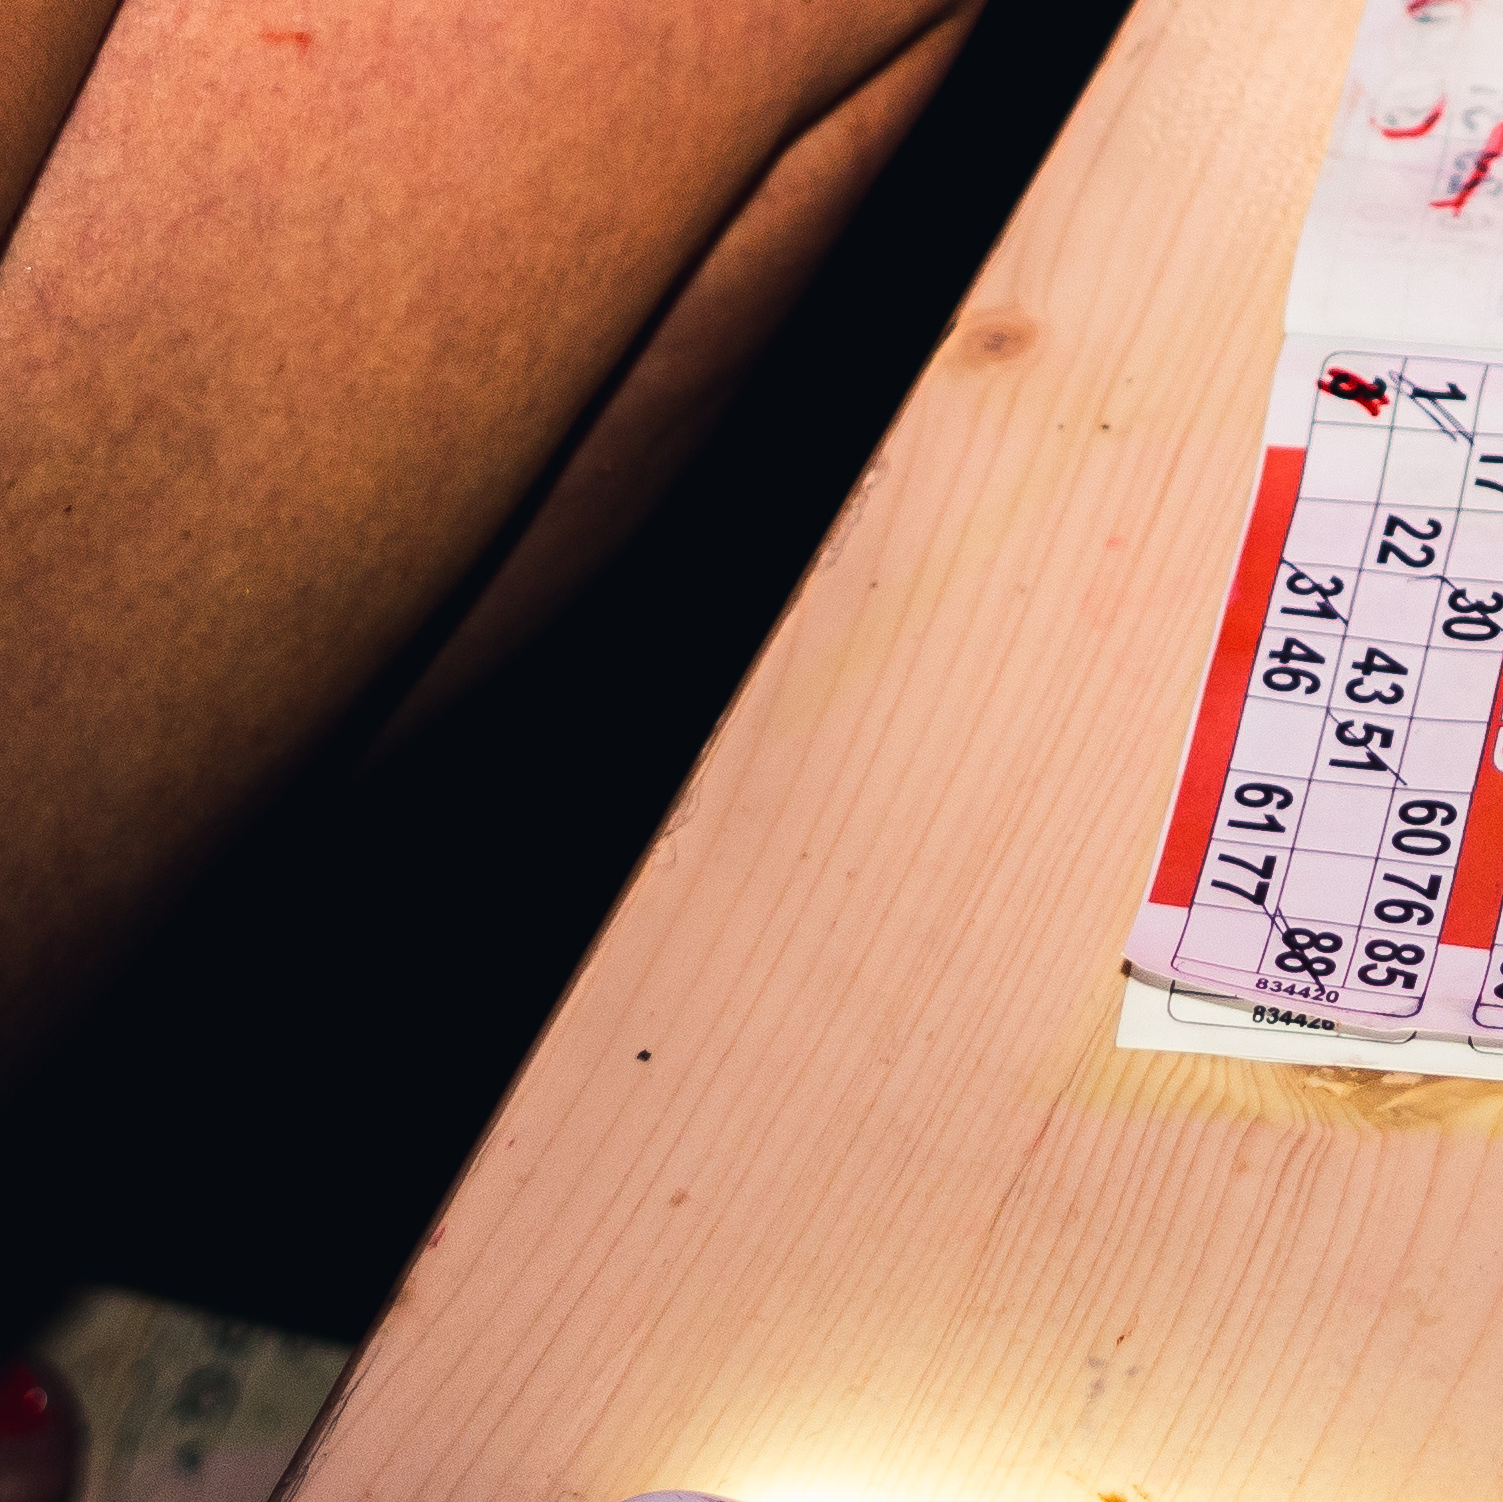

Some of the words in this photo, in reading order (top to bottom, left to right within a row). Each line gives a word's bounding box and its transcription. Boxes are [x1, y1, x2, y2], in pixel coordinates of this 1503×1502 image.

[1376, 514, 1442, 569] 22
[1261, 636, 1328, 696] 46
[1344, 647, 1409, 707] 43
[1329, 719, 1394, 774] 51
[1228, 783, 1294, 836] 61
[1391, 799, 1458, 857] 60
[1211, 853, 1278, 906] 77
[1374, 874, 1442, 927] 76
[1275, 928, 1344, 978] 88
[1356, 939, 1426, 992] 85
[1254, 977, 1340, 1005] 834420
